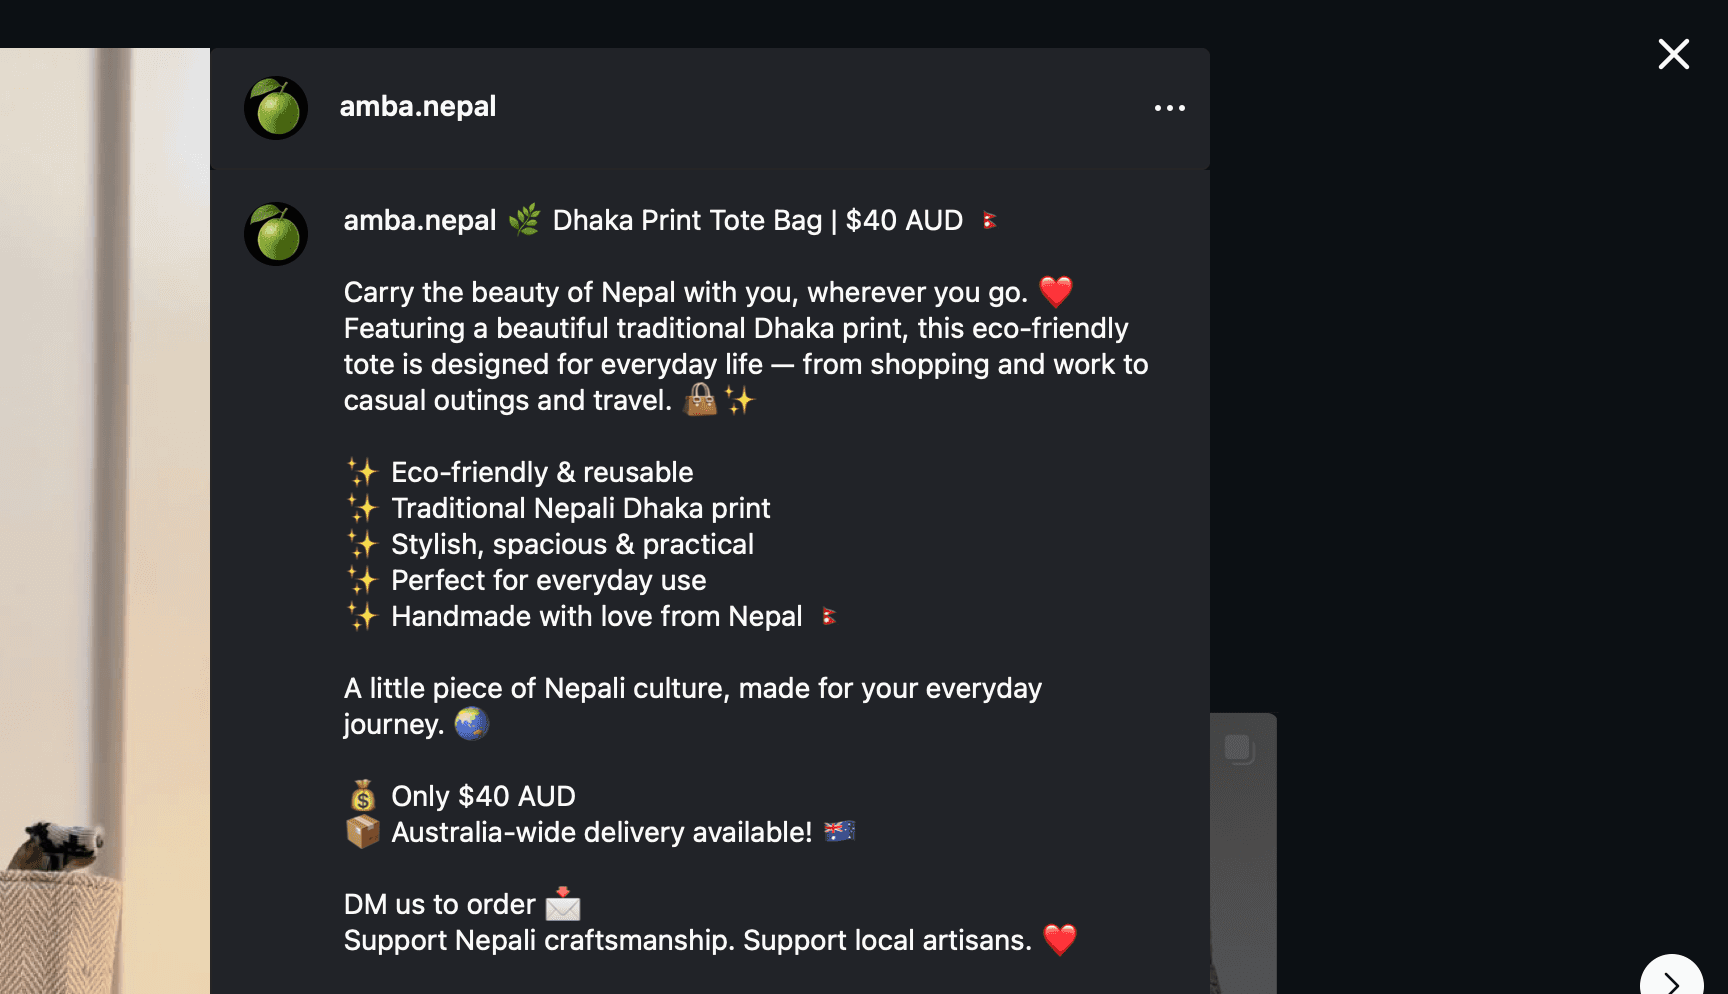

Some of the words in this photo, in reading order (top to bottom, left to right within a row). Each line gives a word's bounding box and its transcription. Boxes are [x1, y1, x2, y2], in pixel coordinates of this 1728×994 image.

[339, 93, 496, 122] amba.nepal
[343, 207, 496, 236] amba.nepal
[553, 208, 633, 231] Dhaka
[642, 207, 702, 231] Print
[709, 208, 766, 231] Tote
[774, 208, 822, 236] Bag
[845, 206, 897, 233] $40
[905, 208, 964, 232] AUD
[344, 280, 415, 308] Carry
[421, 280, 464, 303] the
[472, 280, 560, 308] beauty
[567, 279, 594, 303] of
[602, 280, 675, 308] Nepal
[683, 279, 737, 303] with
[744, 285, 798, 308] you,
[806, 280, 927, 303] wherever
[933, 285, 980, 308] you
[988, 285, 1028, 308] go.
[344, 315, 465, 344] Featuring
[473, 321, 488, 339] a
[497, 315, 608, 339] beautiful
[616, 315, 745, 339] traditional
[754, 316, 834, 339] Dhaka
[843, 315, 908, 344] print,
[917, 315, 965, 339] this
[972, 315, 1130, 344] eco-friendly
[343, 354, 395, 375] tote
[402, 351, 423, 375] is
[430, 351, 549, 380] designed
[556, 351, 594, 375] for
[600, 352, 718, 380] everyday
[726, 351, 764, 375] life
[802, 351, 862, 375] from
[870, 351, 989, 380] shopping
[997, 352, 1045, 375] and
[1052, 352, 1117, 375] work
[1122, 354, 1149, 375] to
[343, 388, 426, 411] casual
[433, 387, 530, 416] outings
[537, 388, 585, 411] and
[592, 388, 672, 411] travel.
[392, 459, 549, 488] Eco-friendly
[556, 460, 577, 484] &
[584, 460, 694, 483] reusable
[391, 495, 525, 519] Traditional
[534, 495, 615, 524] Nepali
[623, 496, 703, 519] Dhaka
[712, 495, 771, 524] print
[391, 531, 484, 560] Stylish,
[493, 531, 608, 560] spacious
[615, 532, 636, 556] &
[643, 531, 754, 560] practical
[392, 567, 486, 591] Perfect
[492, 567, 529, 591] for
[536, 568, 654, 596] everyday
[661, 573, 707, 591] use
[392, 604, 532, 627] Handmade
[538, 603, 592, 627] with
[601, 604, 653, 627] love
[660, 603, 720, 627] from
[729, 604, 802, 632] Nepal
[343, 676, 363, 699] A
[370, 675, 426, 699] little
[433, 675, 503, 704] piece
[510, 675, 537, 699] of
[545, 675, 626, 704] Nepali
[633, 676, 730, 704] culture,
[739, 676, 811, 699] made
[817, 675, 854, 699] for
[860, 681, 919, 704] your
[925, 676, 1043, 704] everyday
[342, 711, 444, 740] journey.
[391, 784, 451, 812] Only
[458, 782, 510, 809] $40
[517, 784, 576, 808] AUD
[391, 819, 577, 843] Australia-wide
[583, 819, 686, 848] delivery
[692, 819, 812, 843] available!
[344, 892, 387, 915] DM
[396, 897, 426, 915] us
[432, 894, 459, 915] to
[466, 892, 537, 915] order
[344, 928, 448, 956] Support
[455, 927, 536, 956] Nepali
[544, 927, 735, 956] craftsmanship.
[743, 928, 847, 956] Support
[855, 928, 914, 951] local
[922, 927, 1032, 951] artisans.
